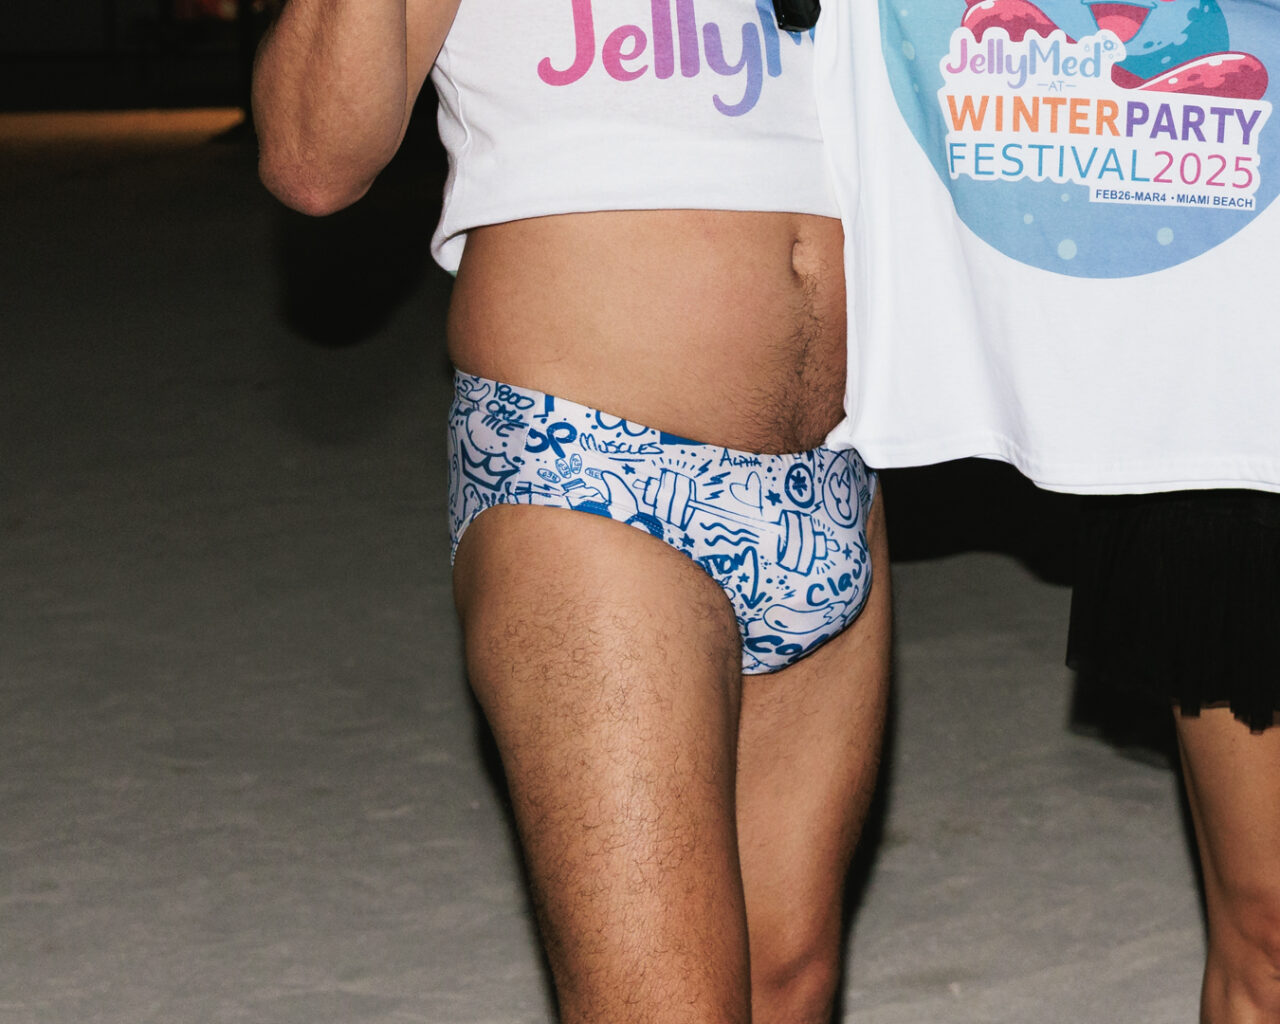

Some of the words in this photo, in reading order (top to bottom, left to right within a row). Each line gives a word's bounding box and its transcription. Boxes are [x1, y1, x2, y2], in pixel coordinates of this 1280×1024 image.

[946, 38, 1101, 89] JellyMed
[1096, 189, 1166, 202] FEB26-MAR4
[1176, 194, 1209, 205] MIAMI
[1213, 197, 1254, 208] BEACH
